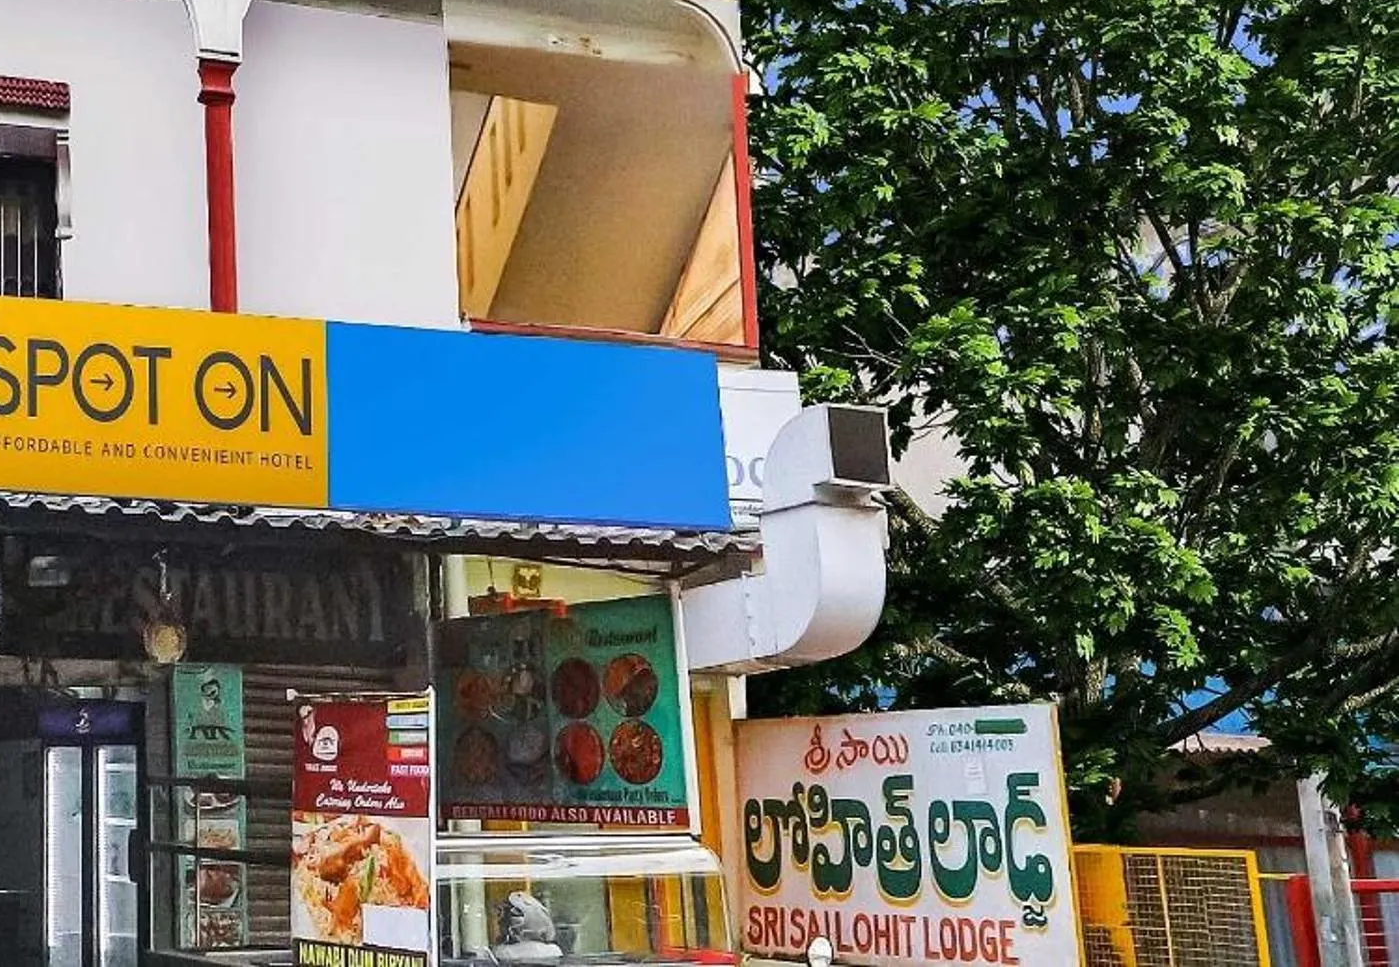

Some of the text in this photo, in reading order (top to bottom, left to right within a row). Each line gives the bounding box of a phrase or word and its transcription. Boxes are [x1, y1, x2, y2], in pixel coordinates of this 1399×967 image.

[194, 351, 313, 436] ON
[101, 443, 135, 458] AND
[143, 445, 253, 465] CONVENIENT
[260, 453, 313, 470] HOTEL
[552, 807, 589, 822] ALSO
[593, 808, 676, 825] AVAILABLE
[747, 905, 1019, 965] SRI SAI LOHIT LODGE
